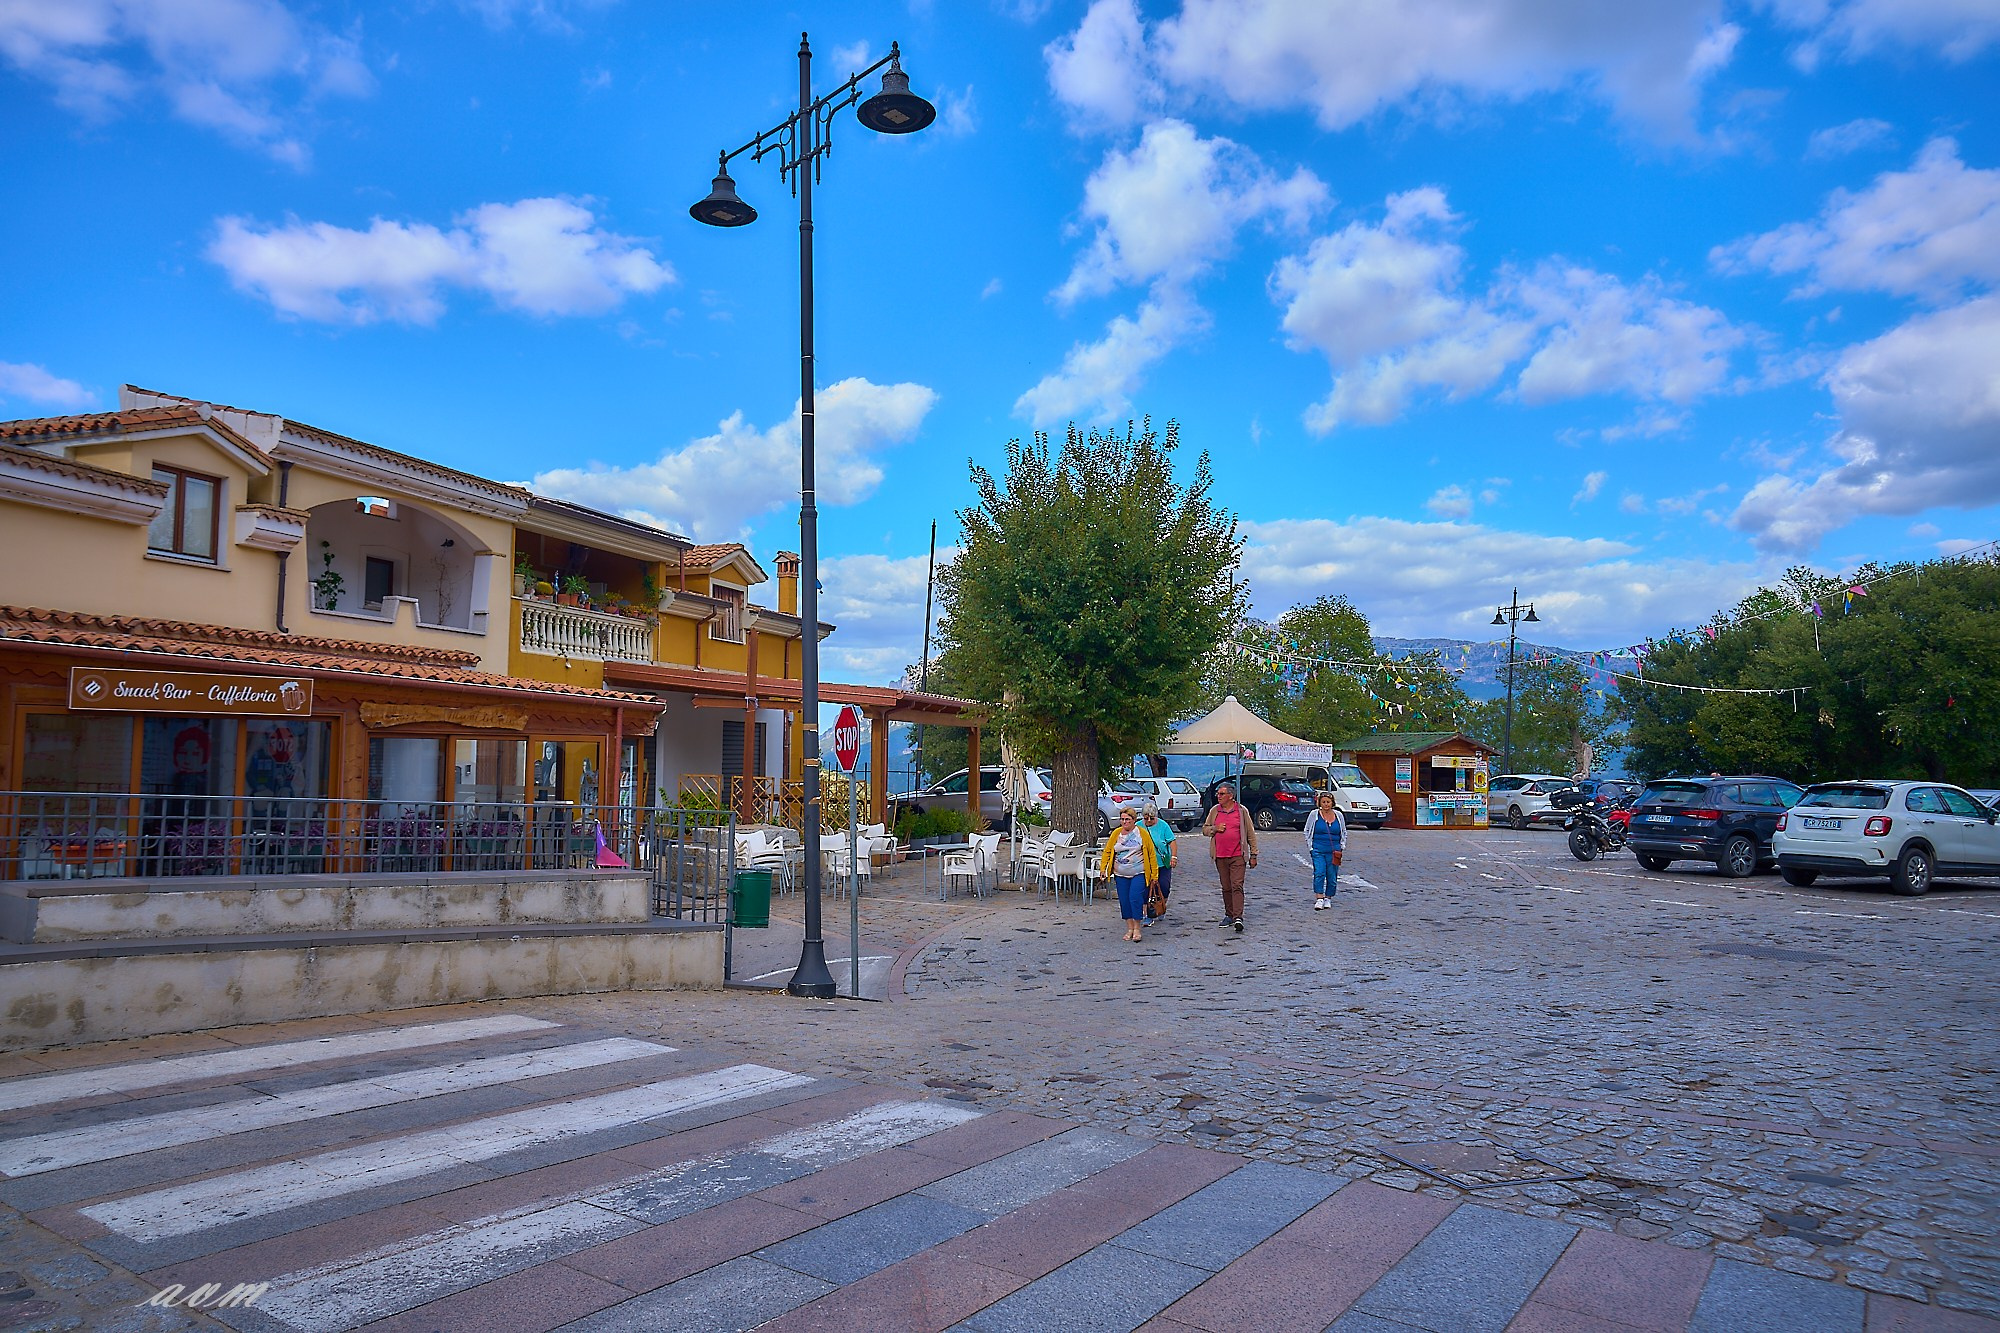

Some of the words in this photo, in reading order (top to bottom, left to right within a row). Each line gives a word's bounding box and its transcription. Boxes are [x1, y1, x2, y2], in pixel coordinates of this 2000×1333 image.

[113, 680, 160, 700] Snack
[162, 682, 192, 700] Bar
[207, 684, 278, 706] Caffetteria
[836, 726, 858, 752] STOP
